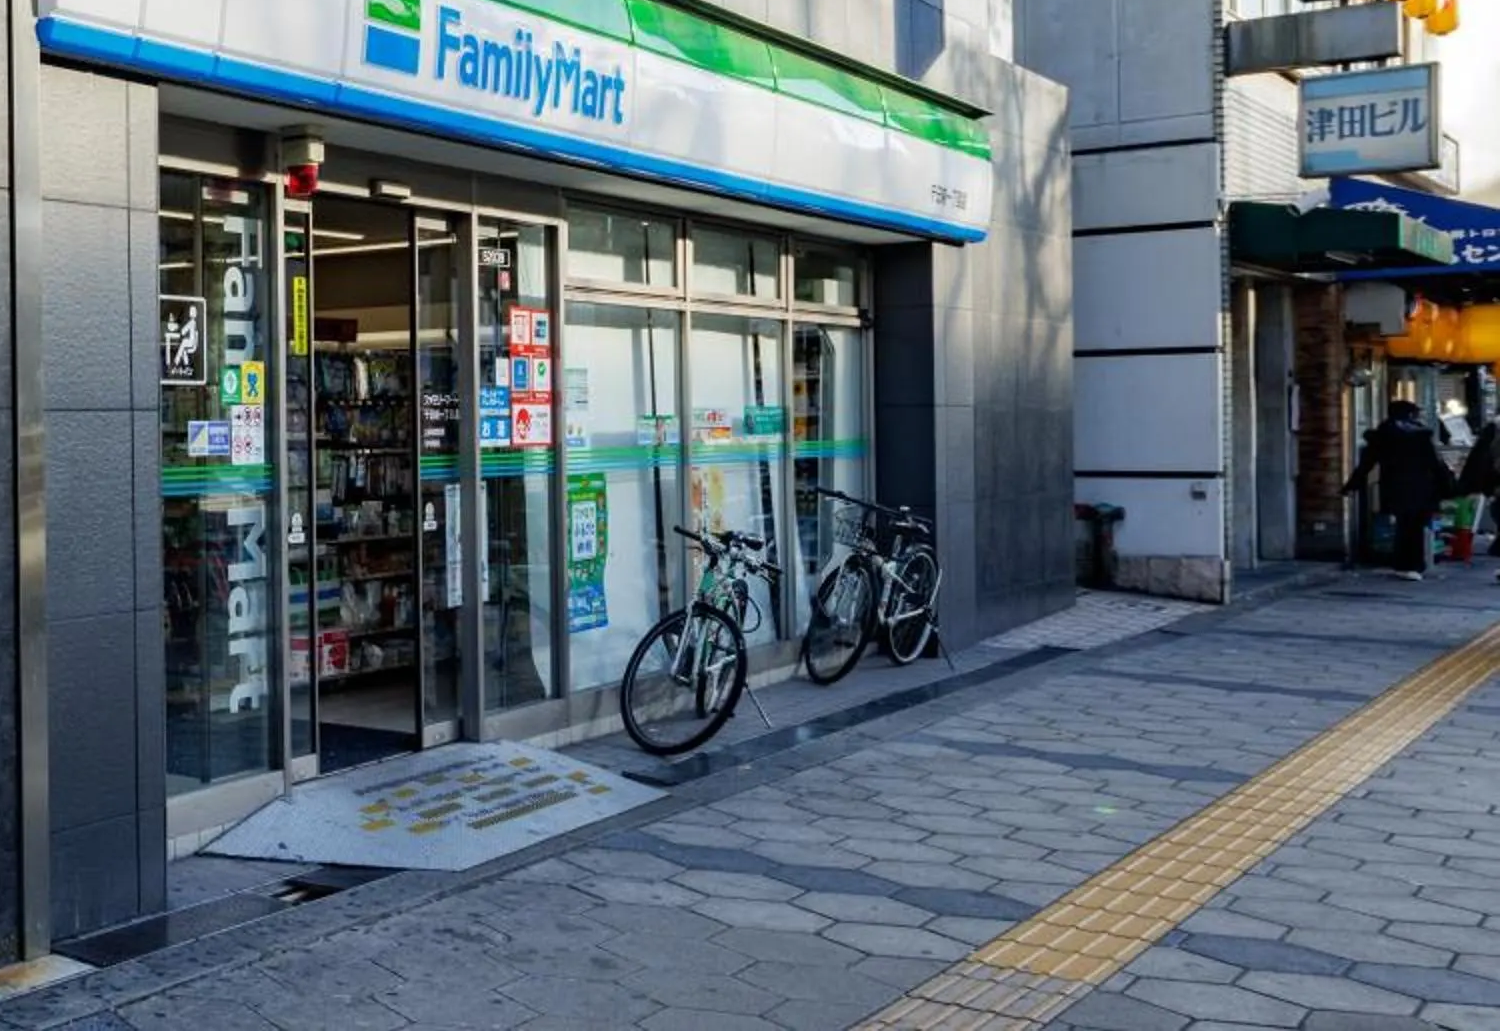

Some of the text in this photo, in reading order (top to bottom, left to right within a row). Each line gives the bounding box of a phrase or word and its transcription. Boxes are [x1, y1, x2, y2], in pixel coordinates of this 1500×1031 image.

[435, 4, 626, 125] FamilyMart
[1306, 96, 1427, 144] 津田ビル
